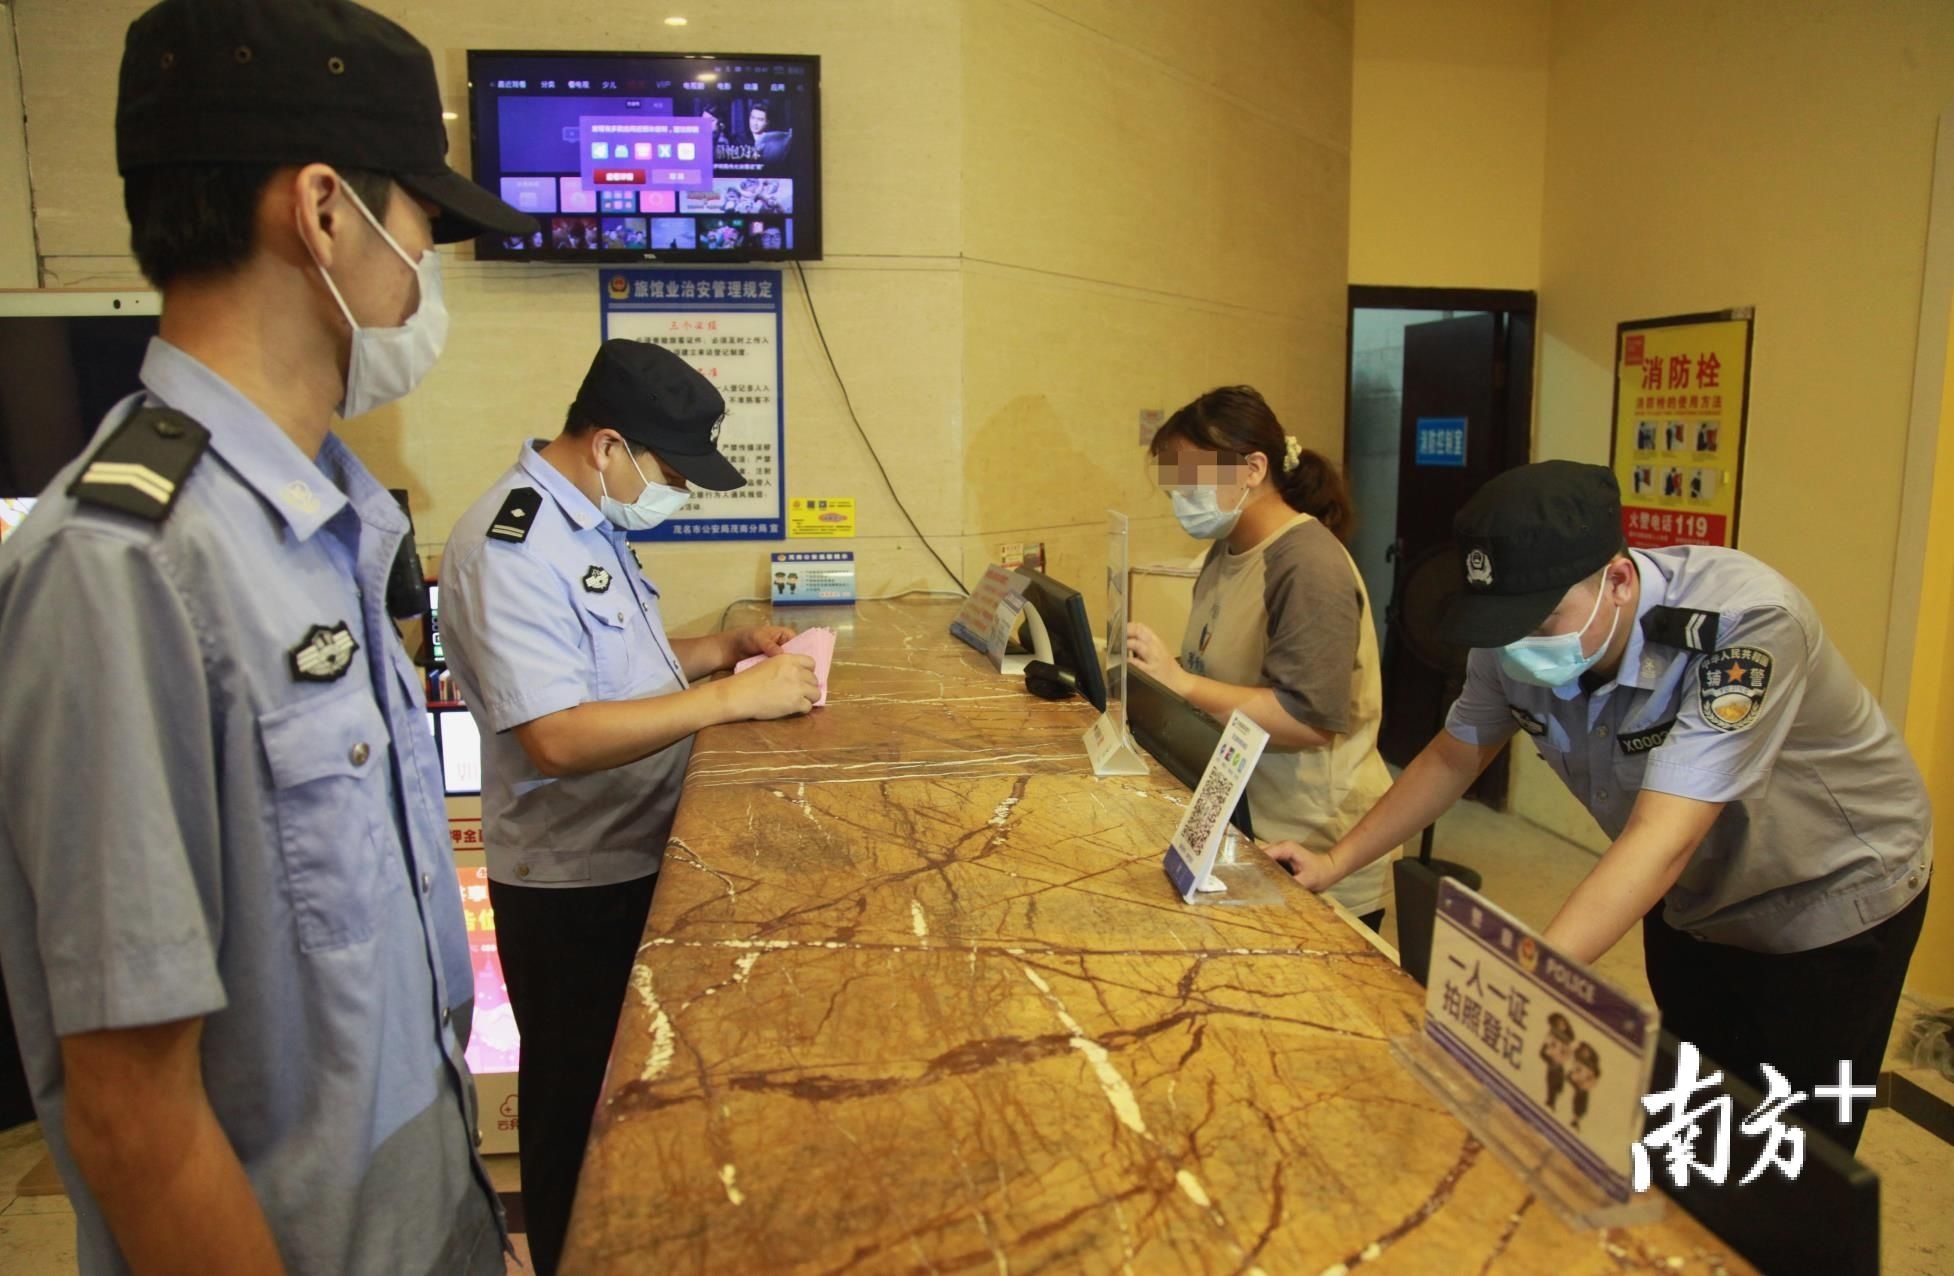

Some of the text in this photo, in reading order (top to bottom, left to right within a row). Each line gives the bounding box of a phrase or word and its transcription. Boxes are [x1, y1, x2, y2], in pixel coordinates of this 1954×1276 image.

[634, 279, 773, 299] 旅馆业治安管理规定
[1641, 352, 1721, 390] 消防栓
[1447, 953, 1530, 1032] 一人一证
[1545, 958, 1596, 1003] POLICE
[1442, 980, 1525, 1069] 拍照登记
